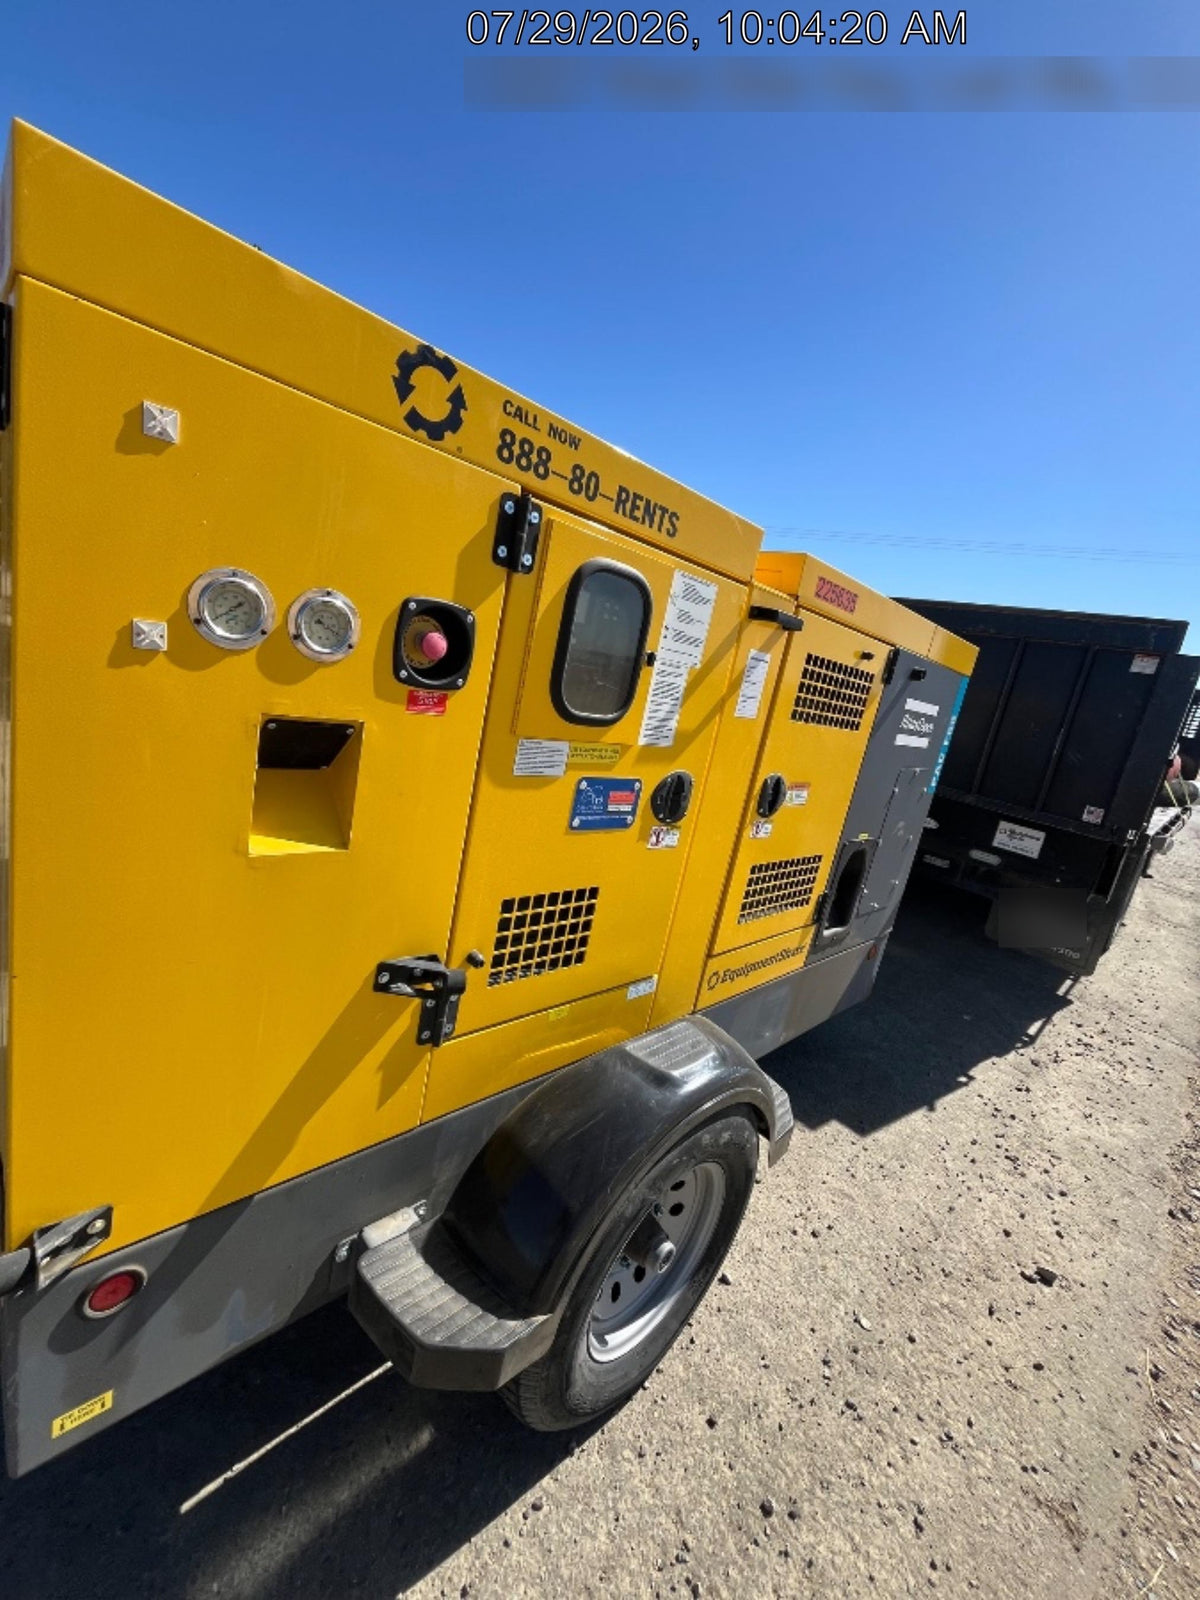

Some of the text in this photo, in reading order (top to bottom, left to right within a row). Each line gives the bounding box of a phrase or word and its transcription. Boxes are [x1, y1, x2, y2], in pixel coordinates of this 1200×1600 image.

[502, 399, 582, 451] CALL NOW
[496, 427, 680, 539] 888-80-RENTS
